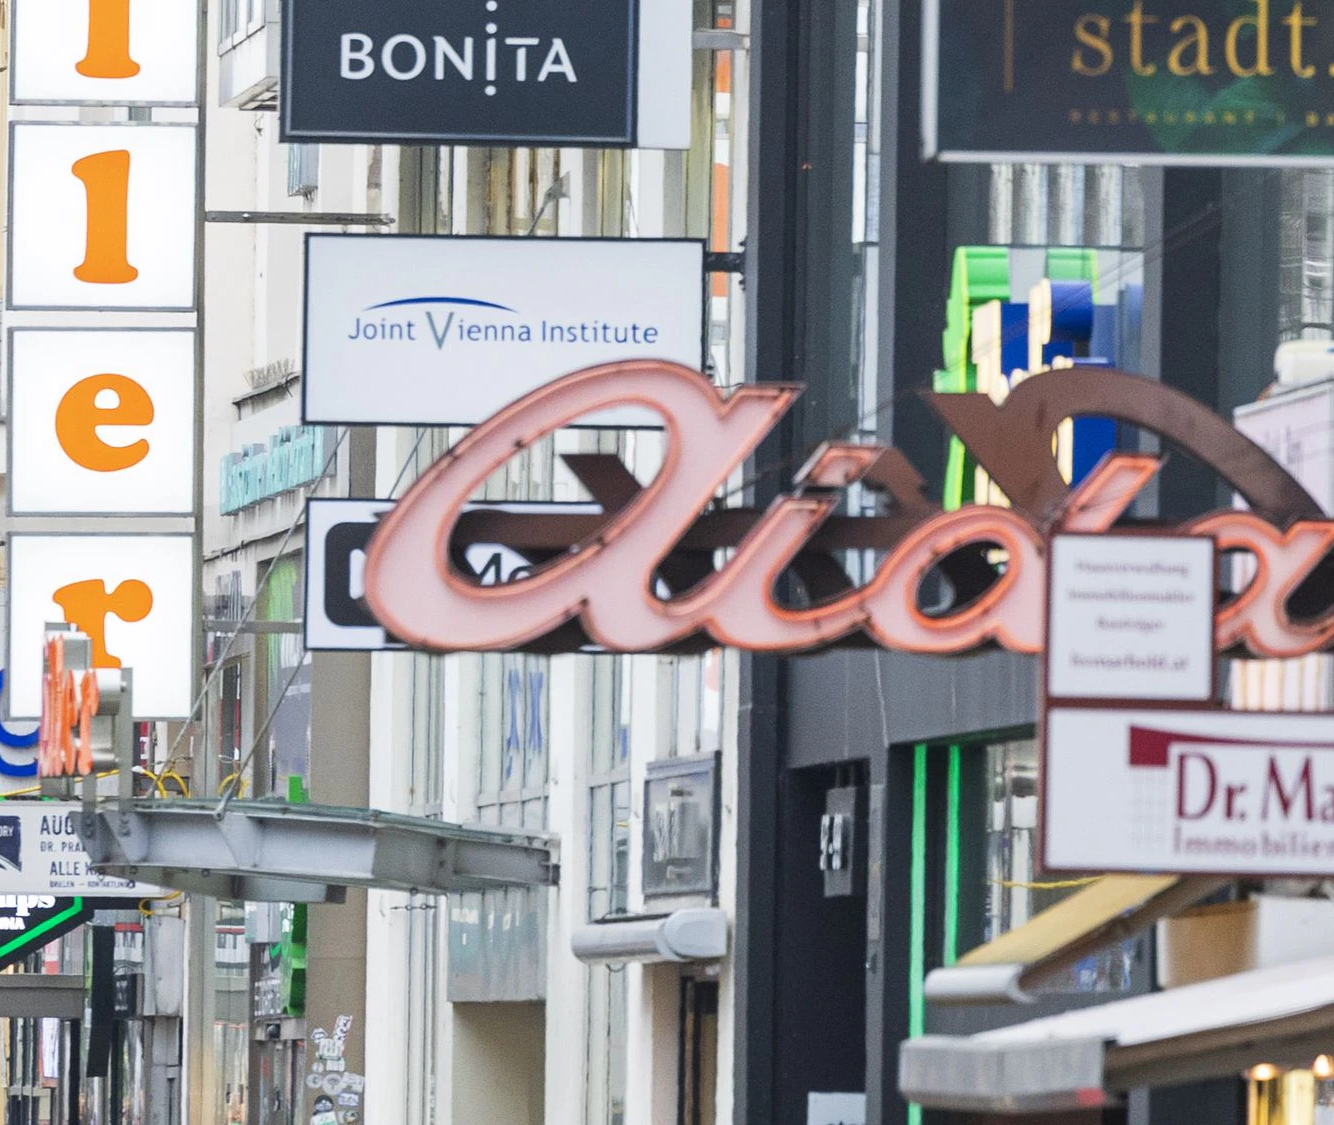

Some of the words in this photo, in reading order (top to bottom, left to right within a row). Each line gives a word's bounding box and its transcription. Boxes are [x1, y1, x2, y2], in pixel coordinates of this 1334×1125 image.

[339, 23, 577, 96] BONITA
[348, 318, 415, 342] Joint
[425, 309, 531, 350] Vienna
[542, 320, 658, 344] Institute
[1176, 752, 1247, 820] Dr.
[50, 861, 80, 876] ALLE
